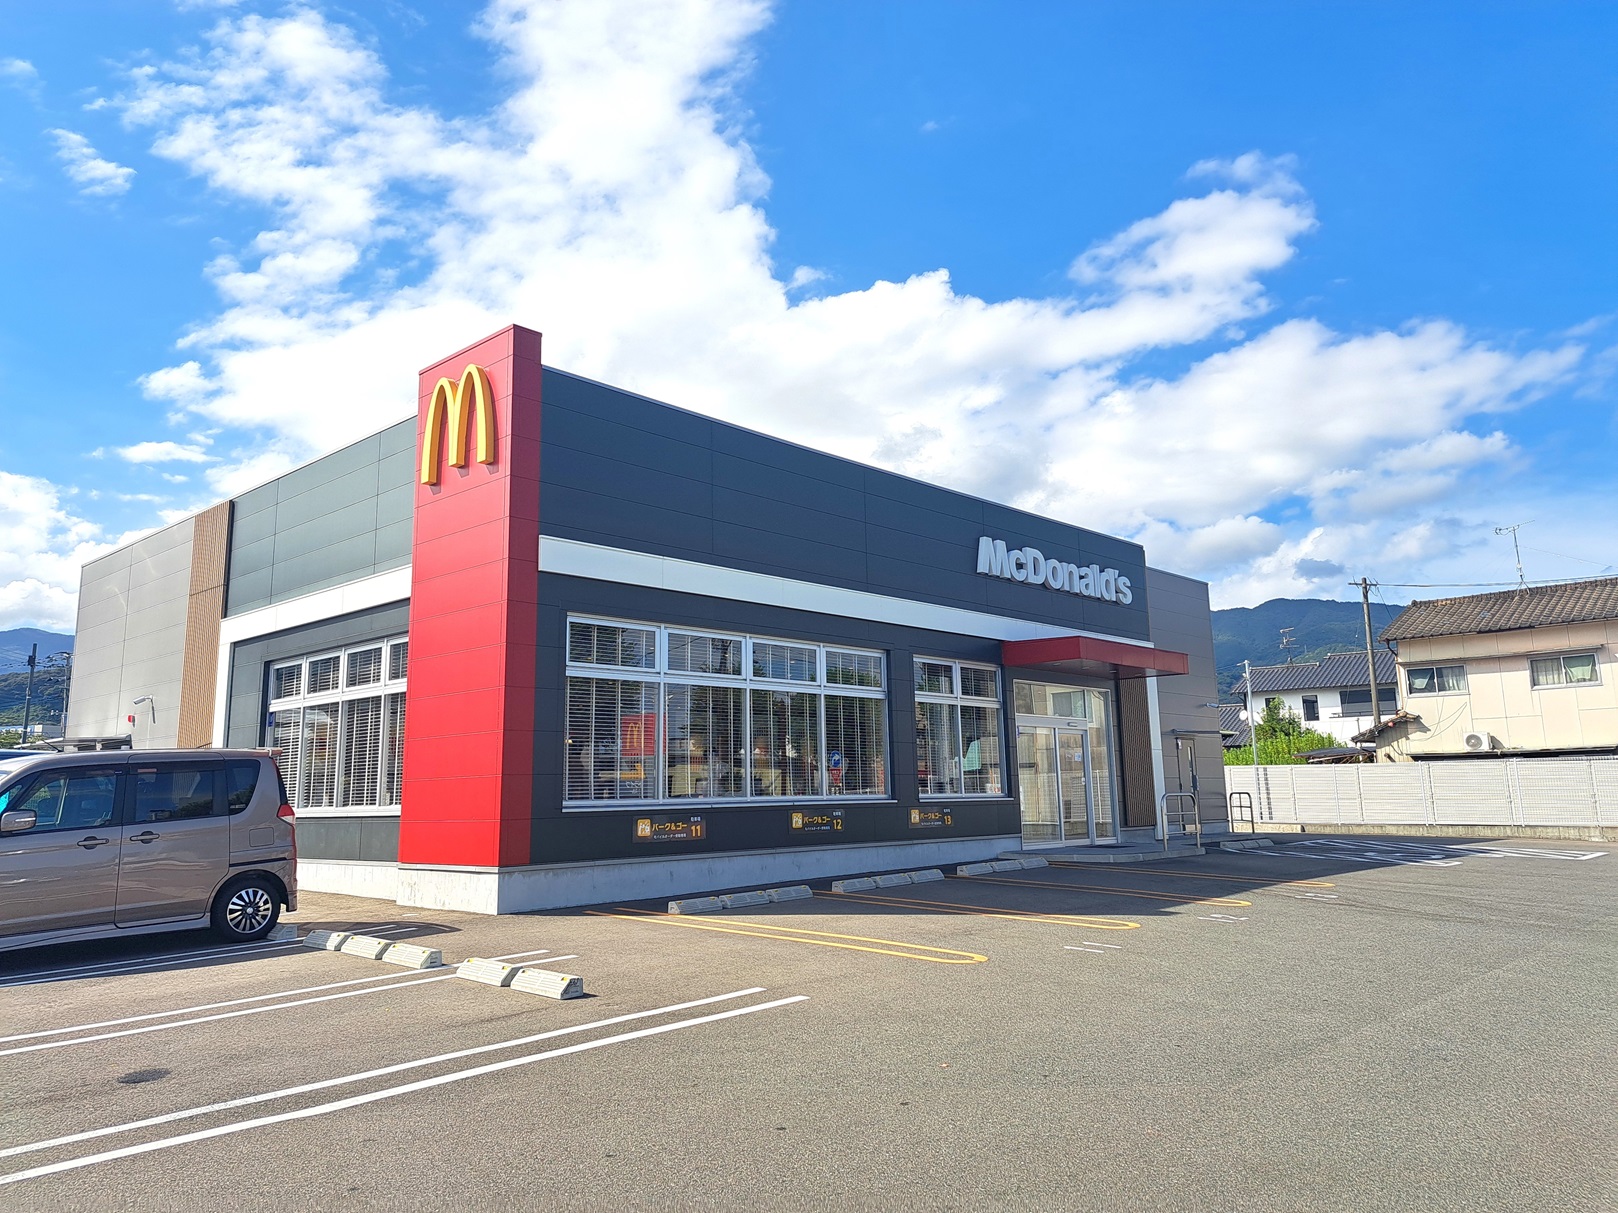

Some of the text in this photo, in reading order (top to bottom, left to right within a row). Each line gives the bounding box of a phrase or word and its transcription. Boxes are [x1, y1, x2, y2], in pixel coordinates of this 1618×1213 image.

[976, 536, 1133, 605] McDonald's
[833, 818, 842, 829] 12
[944, 815, 952, 825] 13
[652, 822, 687, 832] パーク&ゴー
[691, 825, 701, 837] 11
